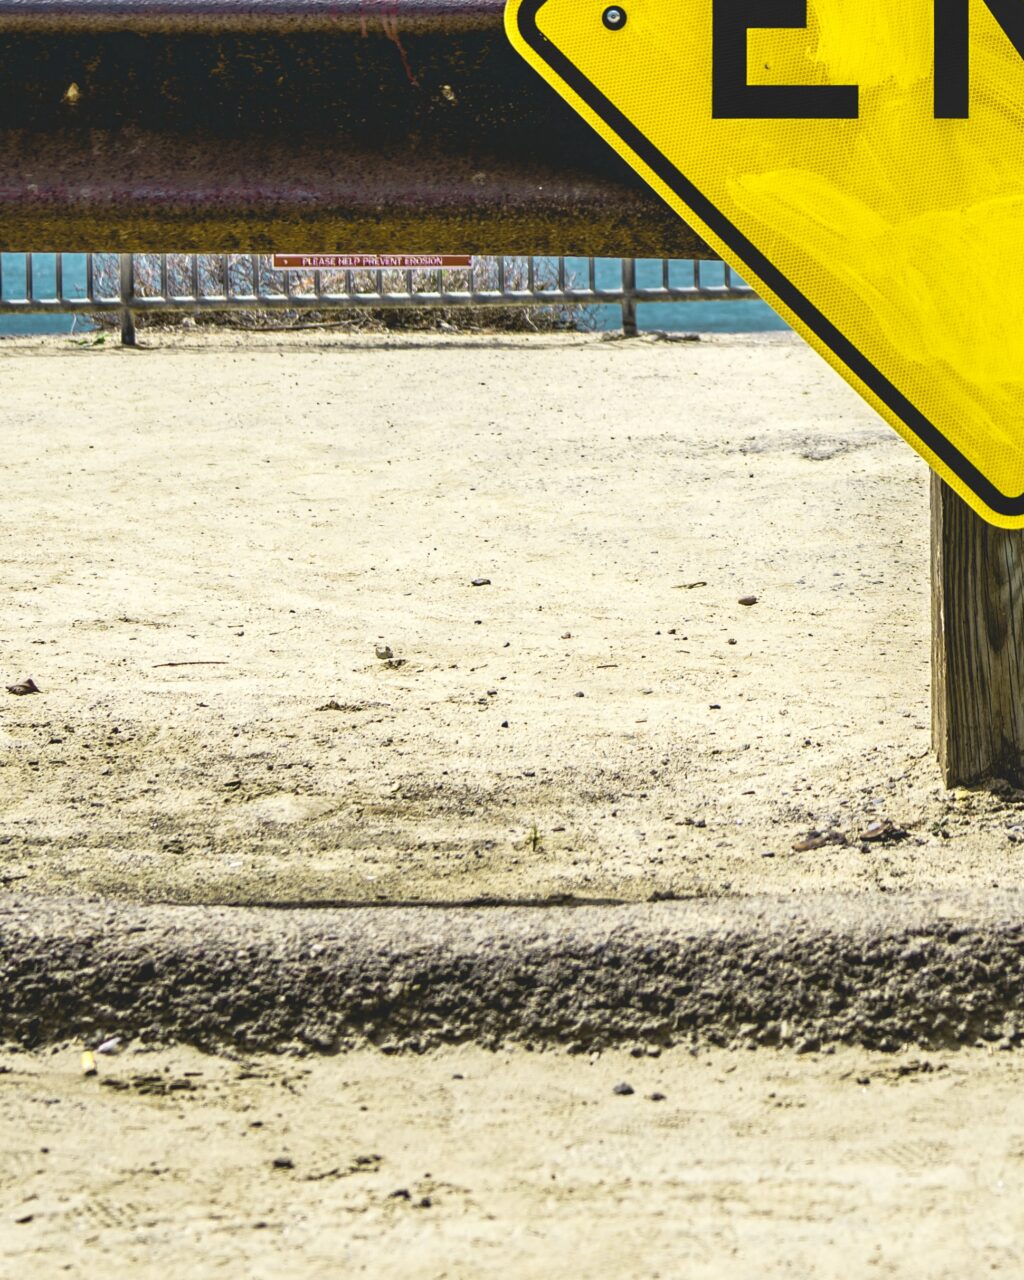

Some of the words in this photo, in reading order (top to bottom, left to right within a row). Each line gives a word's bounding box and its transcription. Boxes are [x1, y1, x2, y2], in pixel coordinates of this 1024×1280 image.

[302, 256, 335, 266] PLEASE
[338, 256, 360, 266] HELP
[363, 256, 401, 266] PREVENT
[404, 256, 443, 266] EROSION
